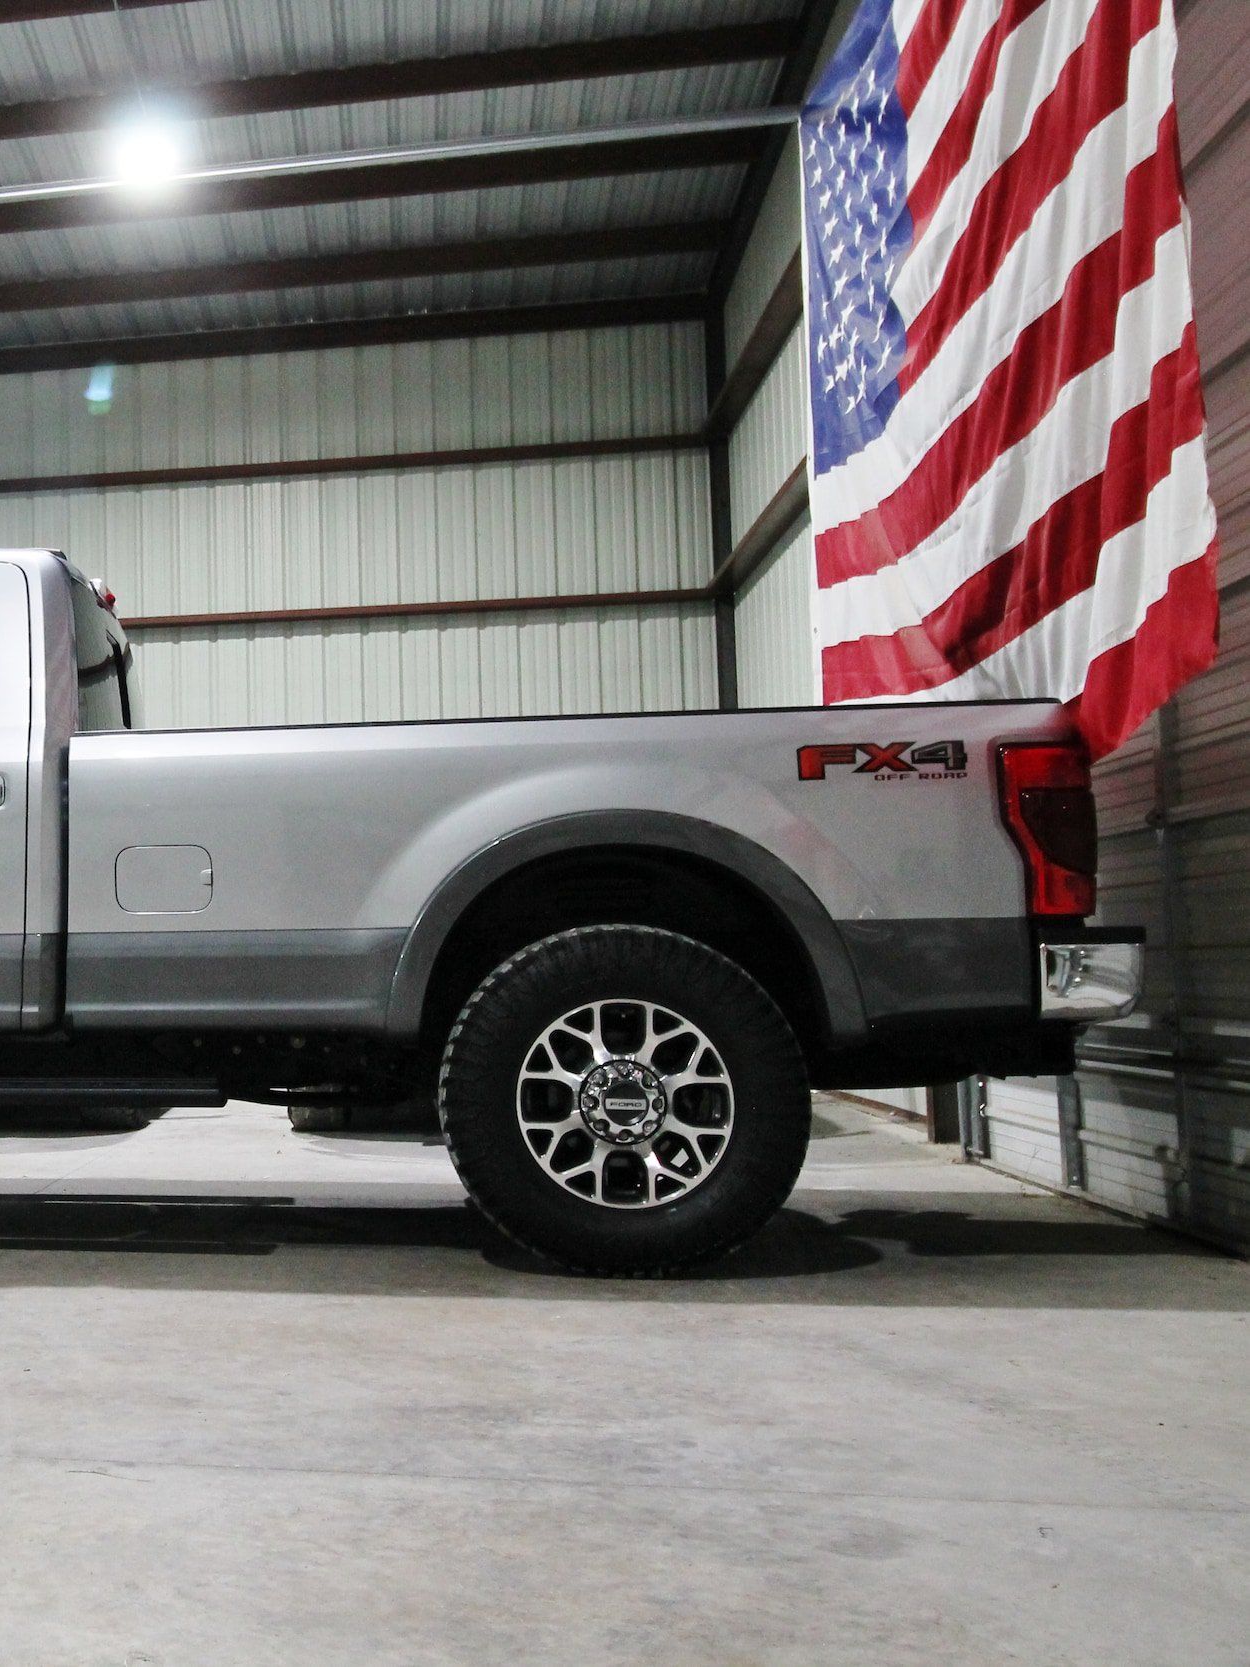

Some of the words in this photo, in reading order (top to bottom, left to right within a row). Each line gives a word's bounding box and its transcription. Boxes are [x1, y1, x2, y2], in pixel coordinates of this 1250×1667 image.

[797, 740, 968, 781] FX4
[874, 773, 911, 782] OFF
[918, 771, 968, 780] ROAD
